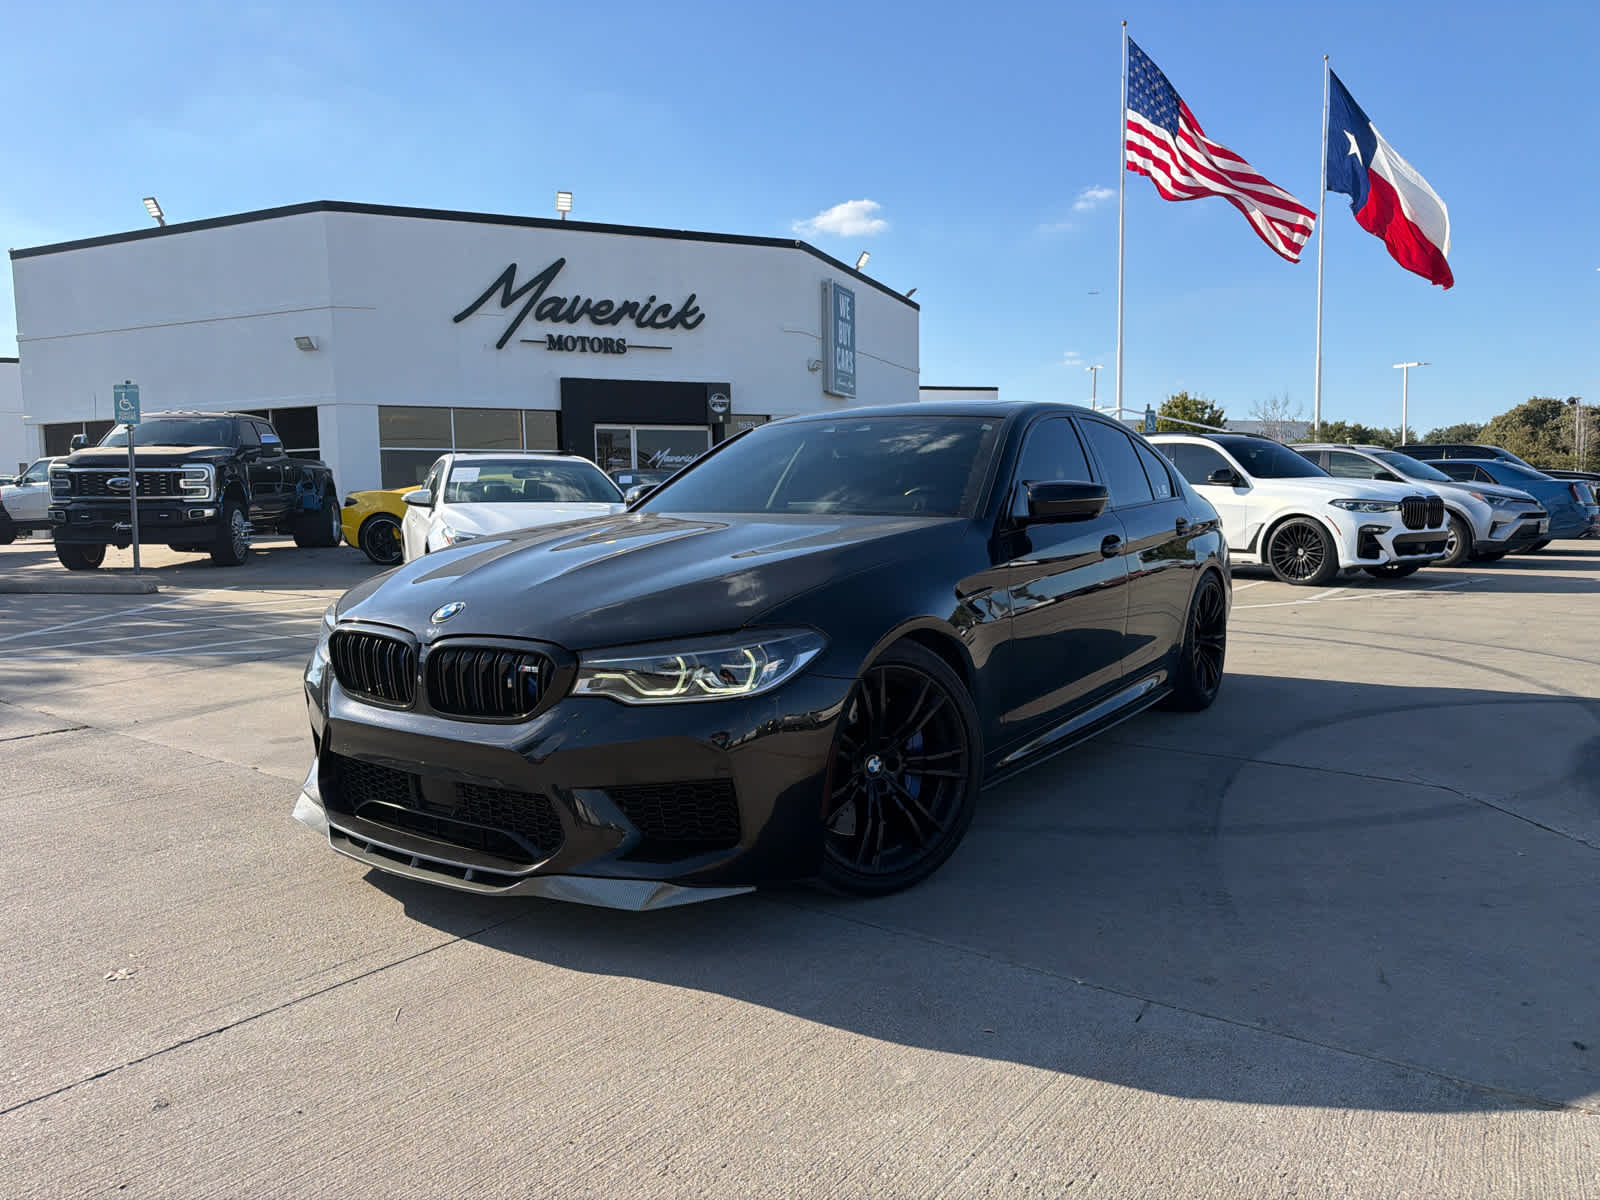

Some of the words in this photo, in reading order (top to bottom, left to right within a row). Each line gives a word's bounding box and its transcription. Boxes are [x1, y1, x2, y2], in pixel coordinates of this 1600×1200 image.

[453, 257, 706, 350] Maverick
[839, 294, 850, 320] WE
[546, 333, 628, 355] MOTORS
[838, 319, 852, 347] BUY
[836, 347, 853, 374] CARS
